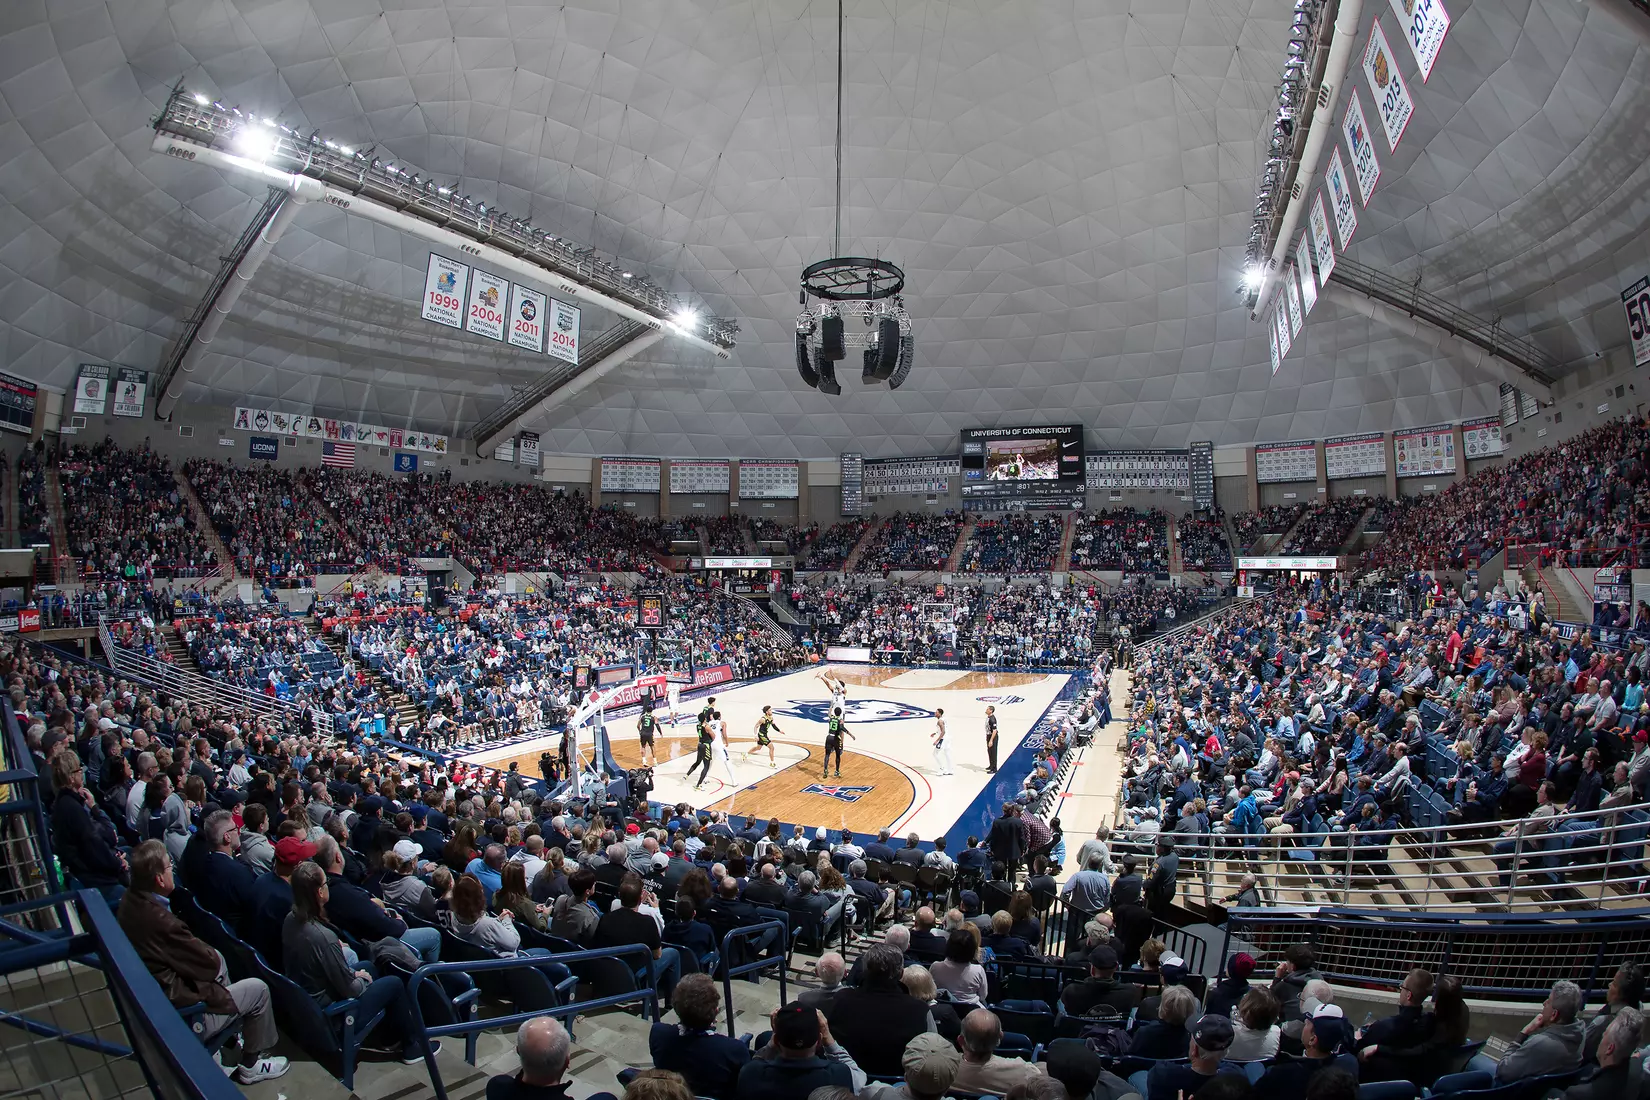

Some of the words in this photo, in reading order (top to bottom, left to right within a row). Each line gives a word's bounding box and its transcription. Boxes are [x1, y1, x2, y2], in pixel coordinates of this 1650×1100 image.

[1410, 0, 1432, 48] 2014
[1420, 16, 1438, 56] NATIONAL
[1424, 21, 1445, 70] CHAMPIONS
[1383, 75, 1400, 122] 2013
[1389, 98, 1405, 132] NATIONAL
[1392, 105, 1410, 144] CHAMPIONS
[1357, 142, 1371, 181] 2010
[1337, 194, 1350, 229] 2009
[439, 264, 459, 274] Basketball
[449, 261, 462, 269] Men's
[430, 292, 459, 310] 1999
[426, 313, 458, 326] CHAMPIONS
[429, 306, 456, 318] NATIONAL
[471, 305, 502, 324] 2004
[1626, 293, 1650, 340] 50
[470, 326, 499, 339] CHAMPIONS
[473, 319, 498, 331] NATIONAL
[515, 320, 539, 336] 2011
[512, 338, 539, 350] CHAMPIONS
[514, 332, 538, 344] NATIONAL
[552, 332, 575, 348] 2014
[550, 350, 575, 362] CHAMPIONS
[553, 344, 573, 355] NATIONAL
[235, 409, 249, 429] A
[273, 415, 288, 431] UCF
[1412, 425, 1450, 434] CHAMPIONSHIP
[390, 430, 403, 446] T
[524, 440, 536, 449] 873
[644, 609, 659, 624] 25
[644, 716, 650, 727] 3
[830, 721, 838, 730] 13
[261, 1063, 271, 1072] N
